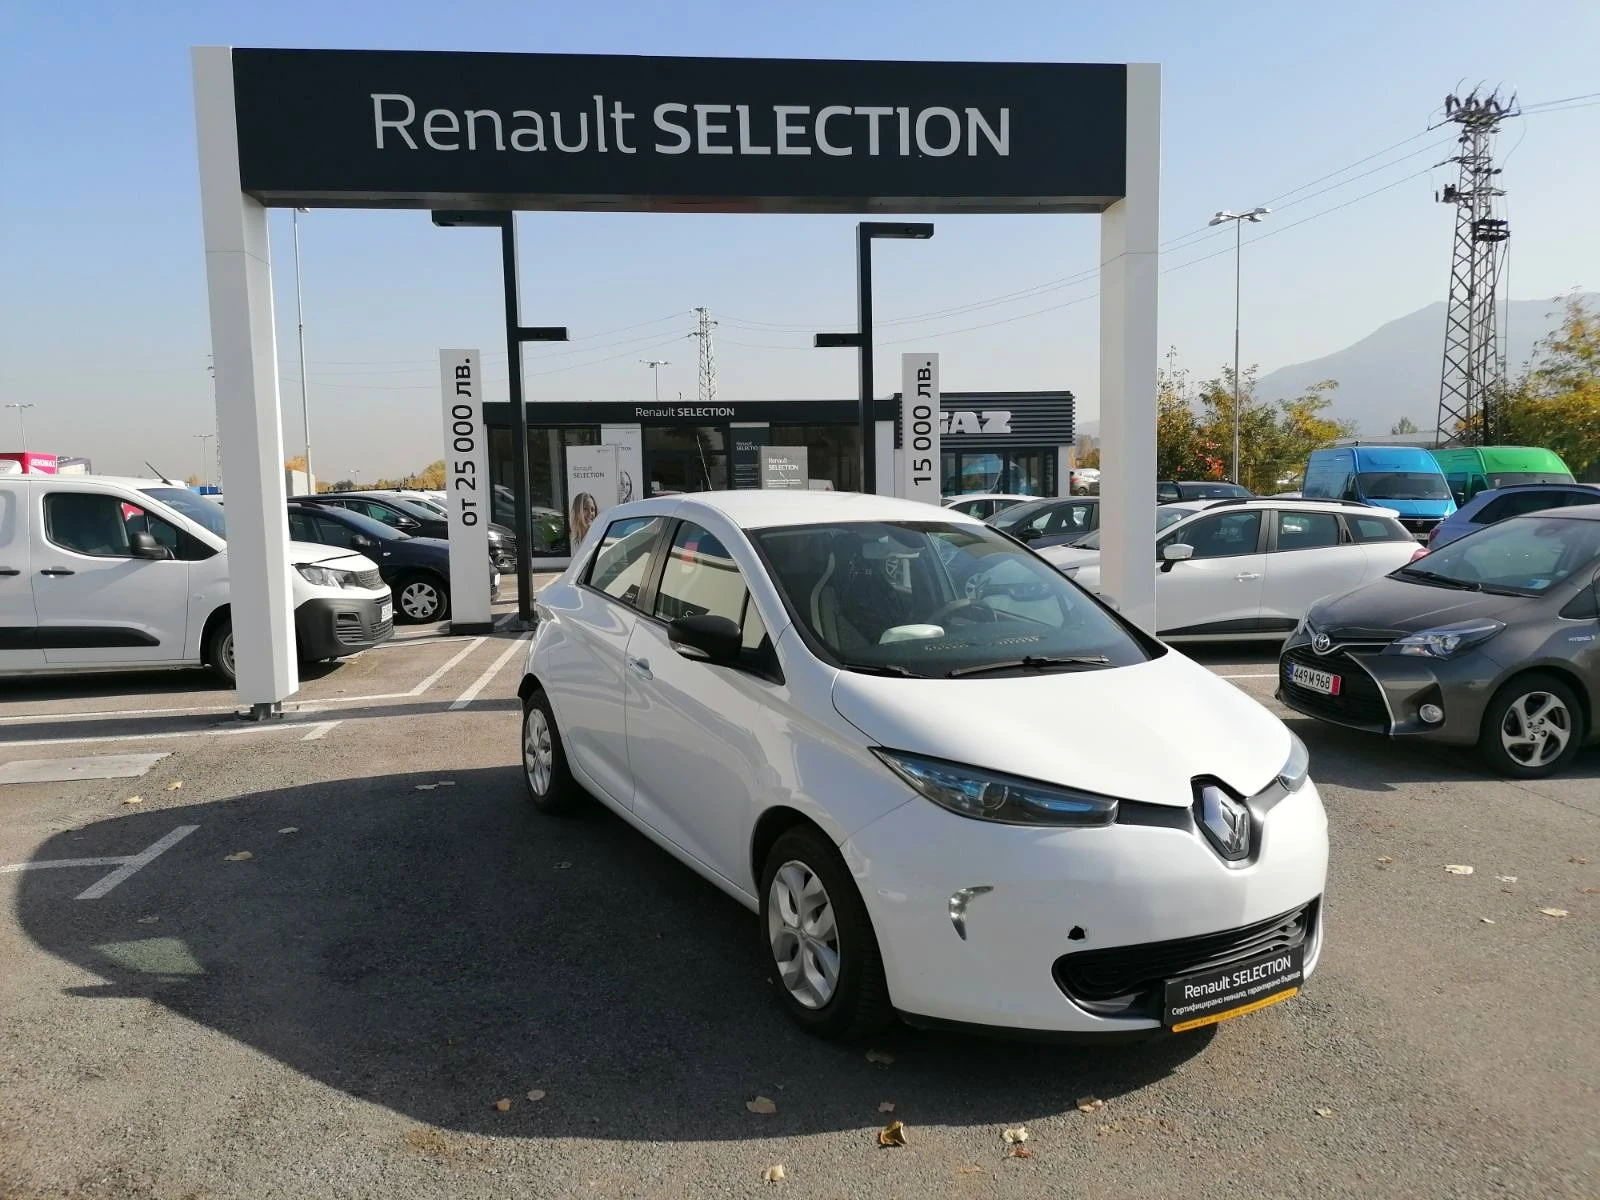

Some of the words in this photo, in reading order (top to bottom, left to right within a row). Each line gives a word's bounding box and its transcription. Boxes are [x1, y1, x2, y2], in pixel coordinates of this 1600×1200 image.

[371, 93, 637, 154] Renault
[653, 102, 1010, 157] SELECTION
[455, 358, 472, 397] лв.
[917, 361, 932, 398] лв.
[451, 404, 475, 453] 000
[635, 407, 675, 417] Renault
[677, 407, 735, 417] SELECTION
[912, 405, 932, 451] 000
[454, 460, 476, 491] 25
[913, 458, 932, 486] 15
[461, 498, 478, 527] от
[1184, 976, 1231, 999] Renault
[1232, 955, 1291, 987] SELECTION
